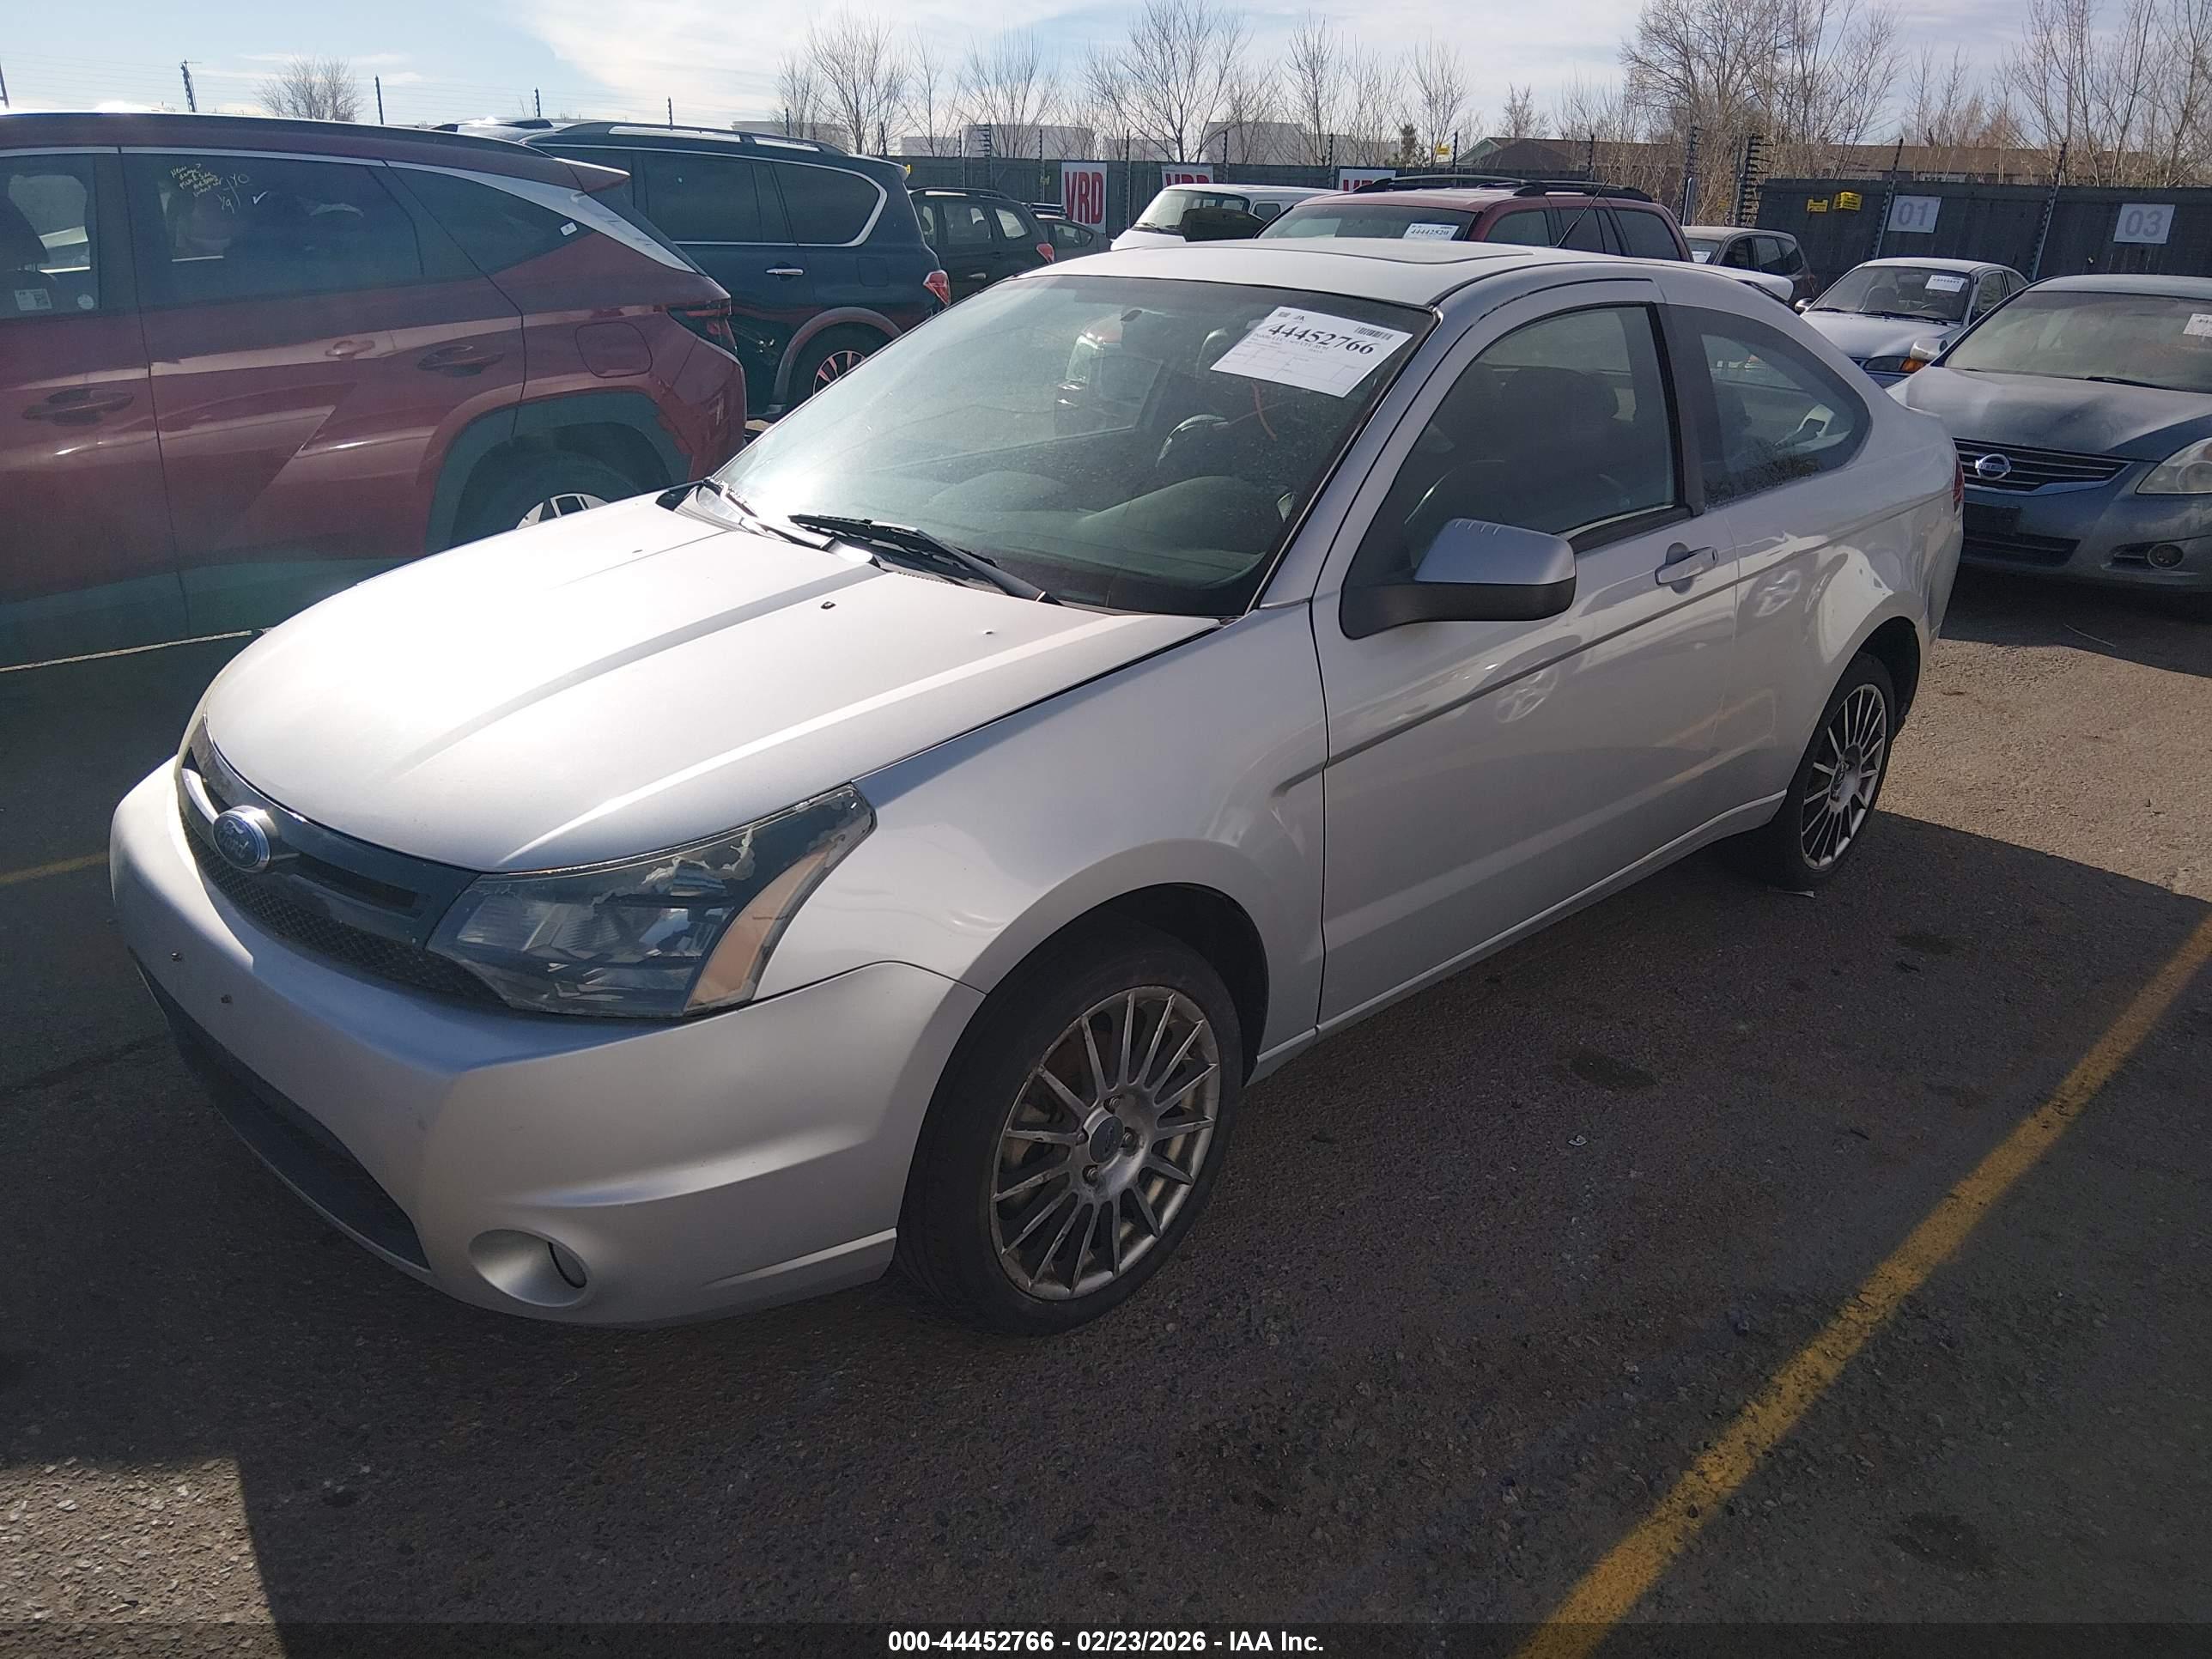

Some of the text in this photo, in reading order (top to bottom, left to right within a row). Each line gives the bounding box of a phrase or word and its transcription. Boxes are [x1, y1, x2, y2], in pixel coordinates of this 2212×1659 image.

[1065, 172, 1103, 224] VRD
[1897, 201, 1929, 227] 01
[2125, 210, 2164, 237] 03
[1268, 324, 1380, 355] 44452766
